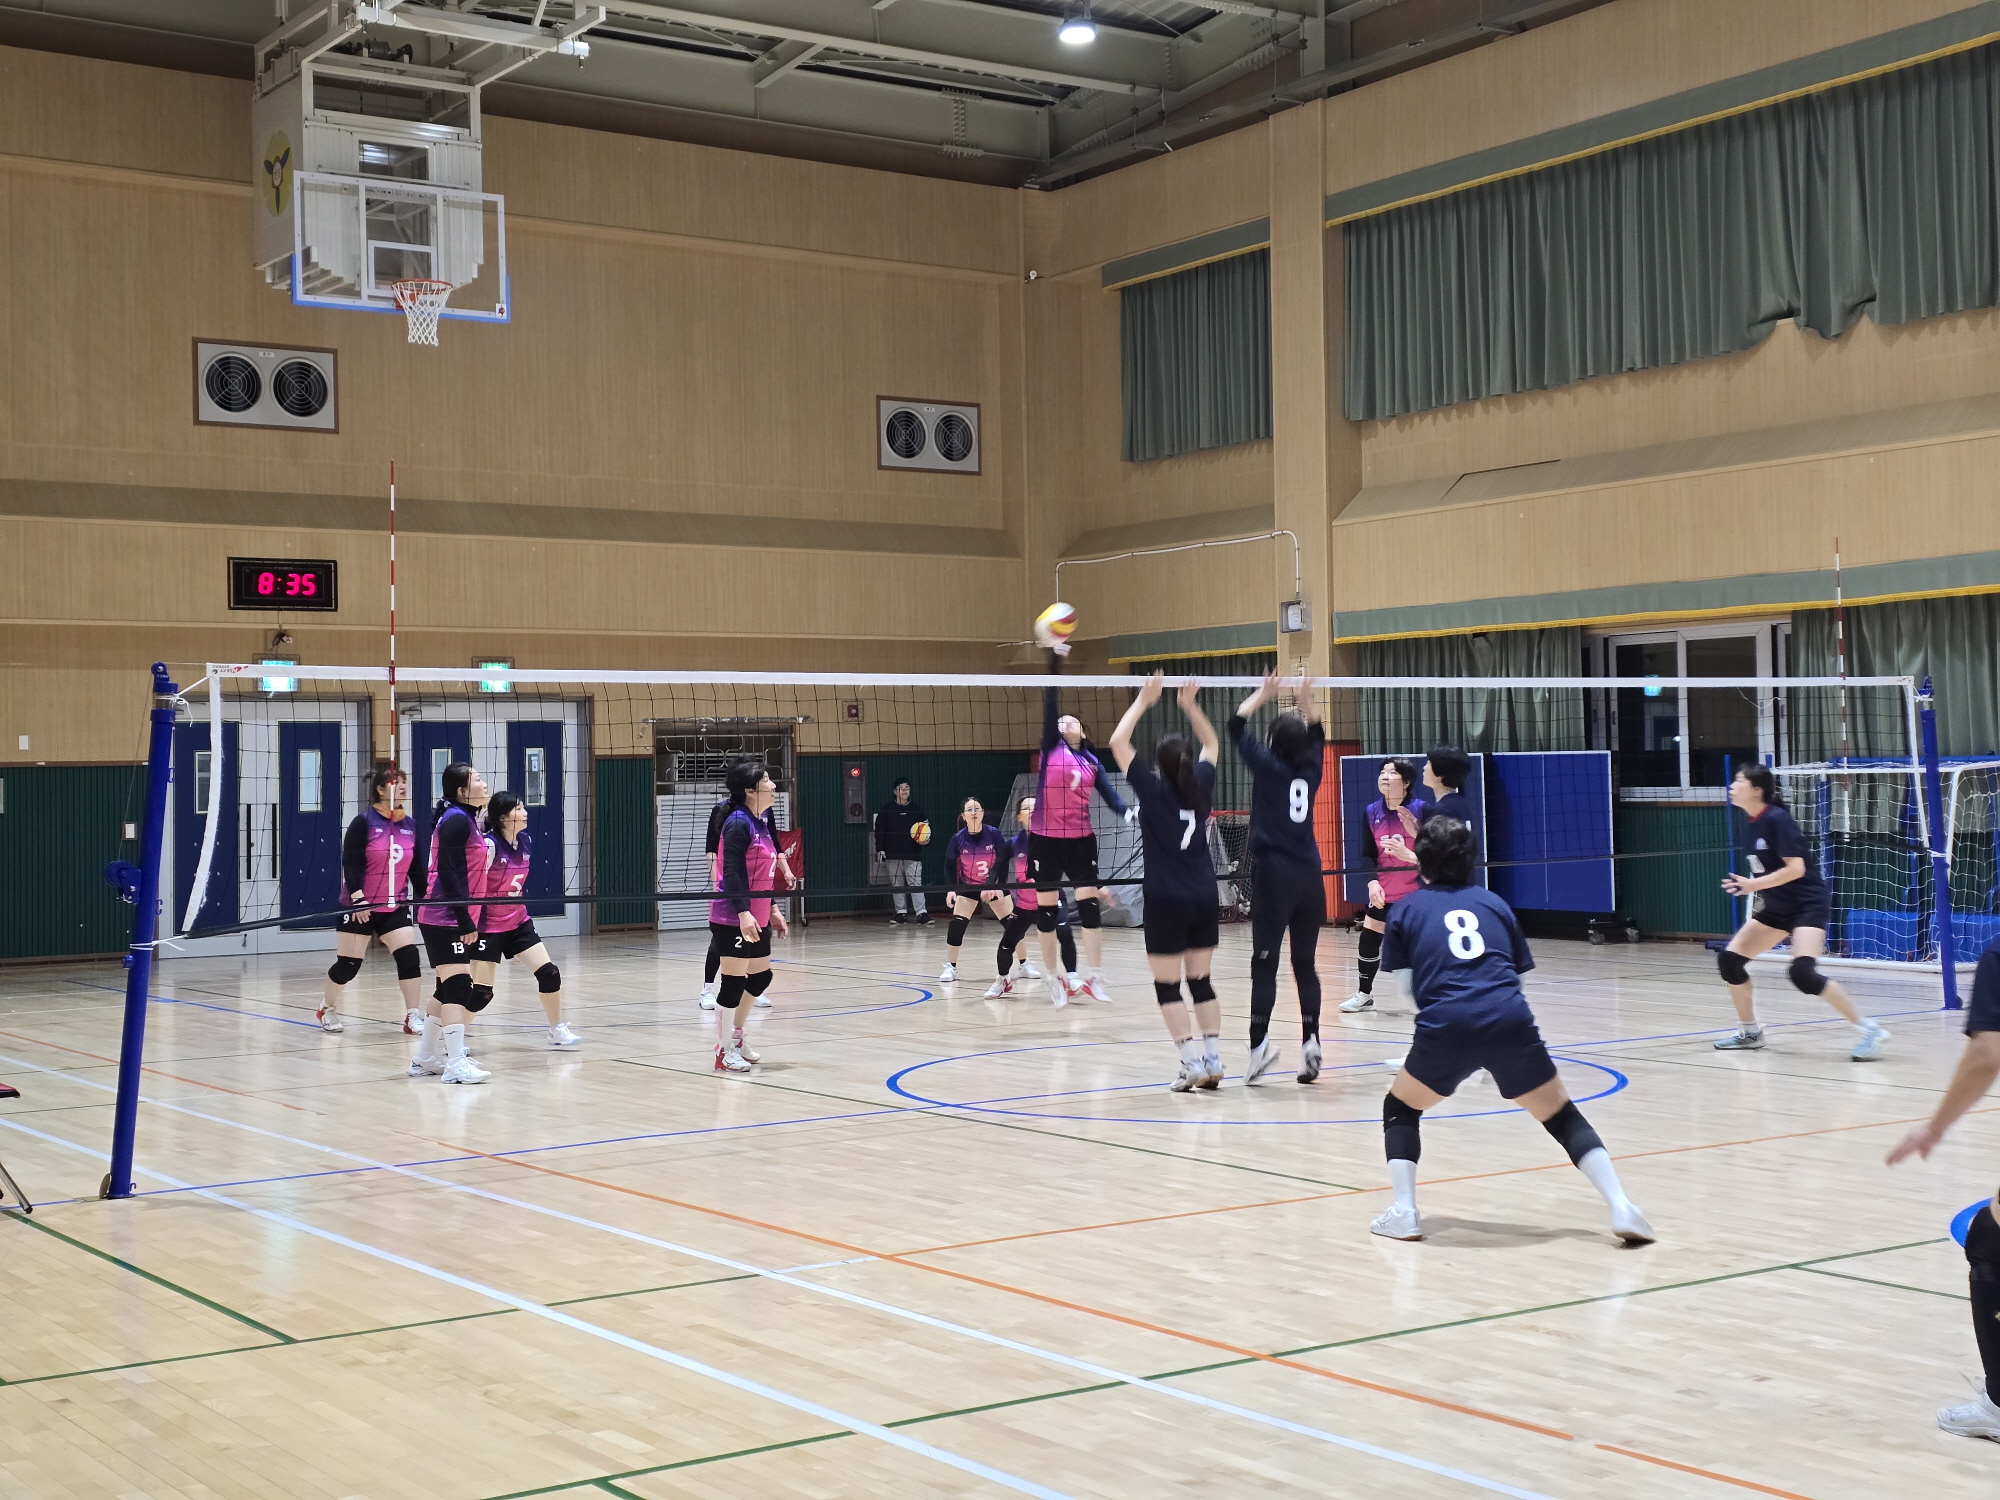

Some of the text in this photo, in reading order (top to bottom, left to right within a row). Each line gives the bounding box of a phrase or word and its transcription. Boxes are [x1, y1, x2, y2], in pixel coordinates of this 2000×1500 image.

[258, 572, 316, 597] 8:35
[1179, 809, 1196, 850] 7
[975, 860, 989, 877] 3
[507, 874, 525, 898] 5
[343, 913, 350, 925] 9
[734, 936, 743, 948] 2
[1444, 909, 1486, 960] 8
[451, 942, 465, 954] 13
[478, 939, 487, 951] 5
